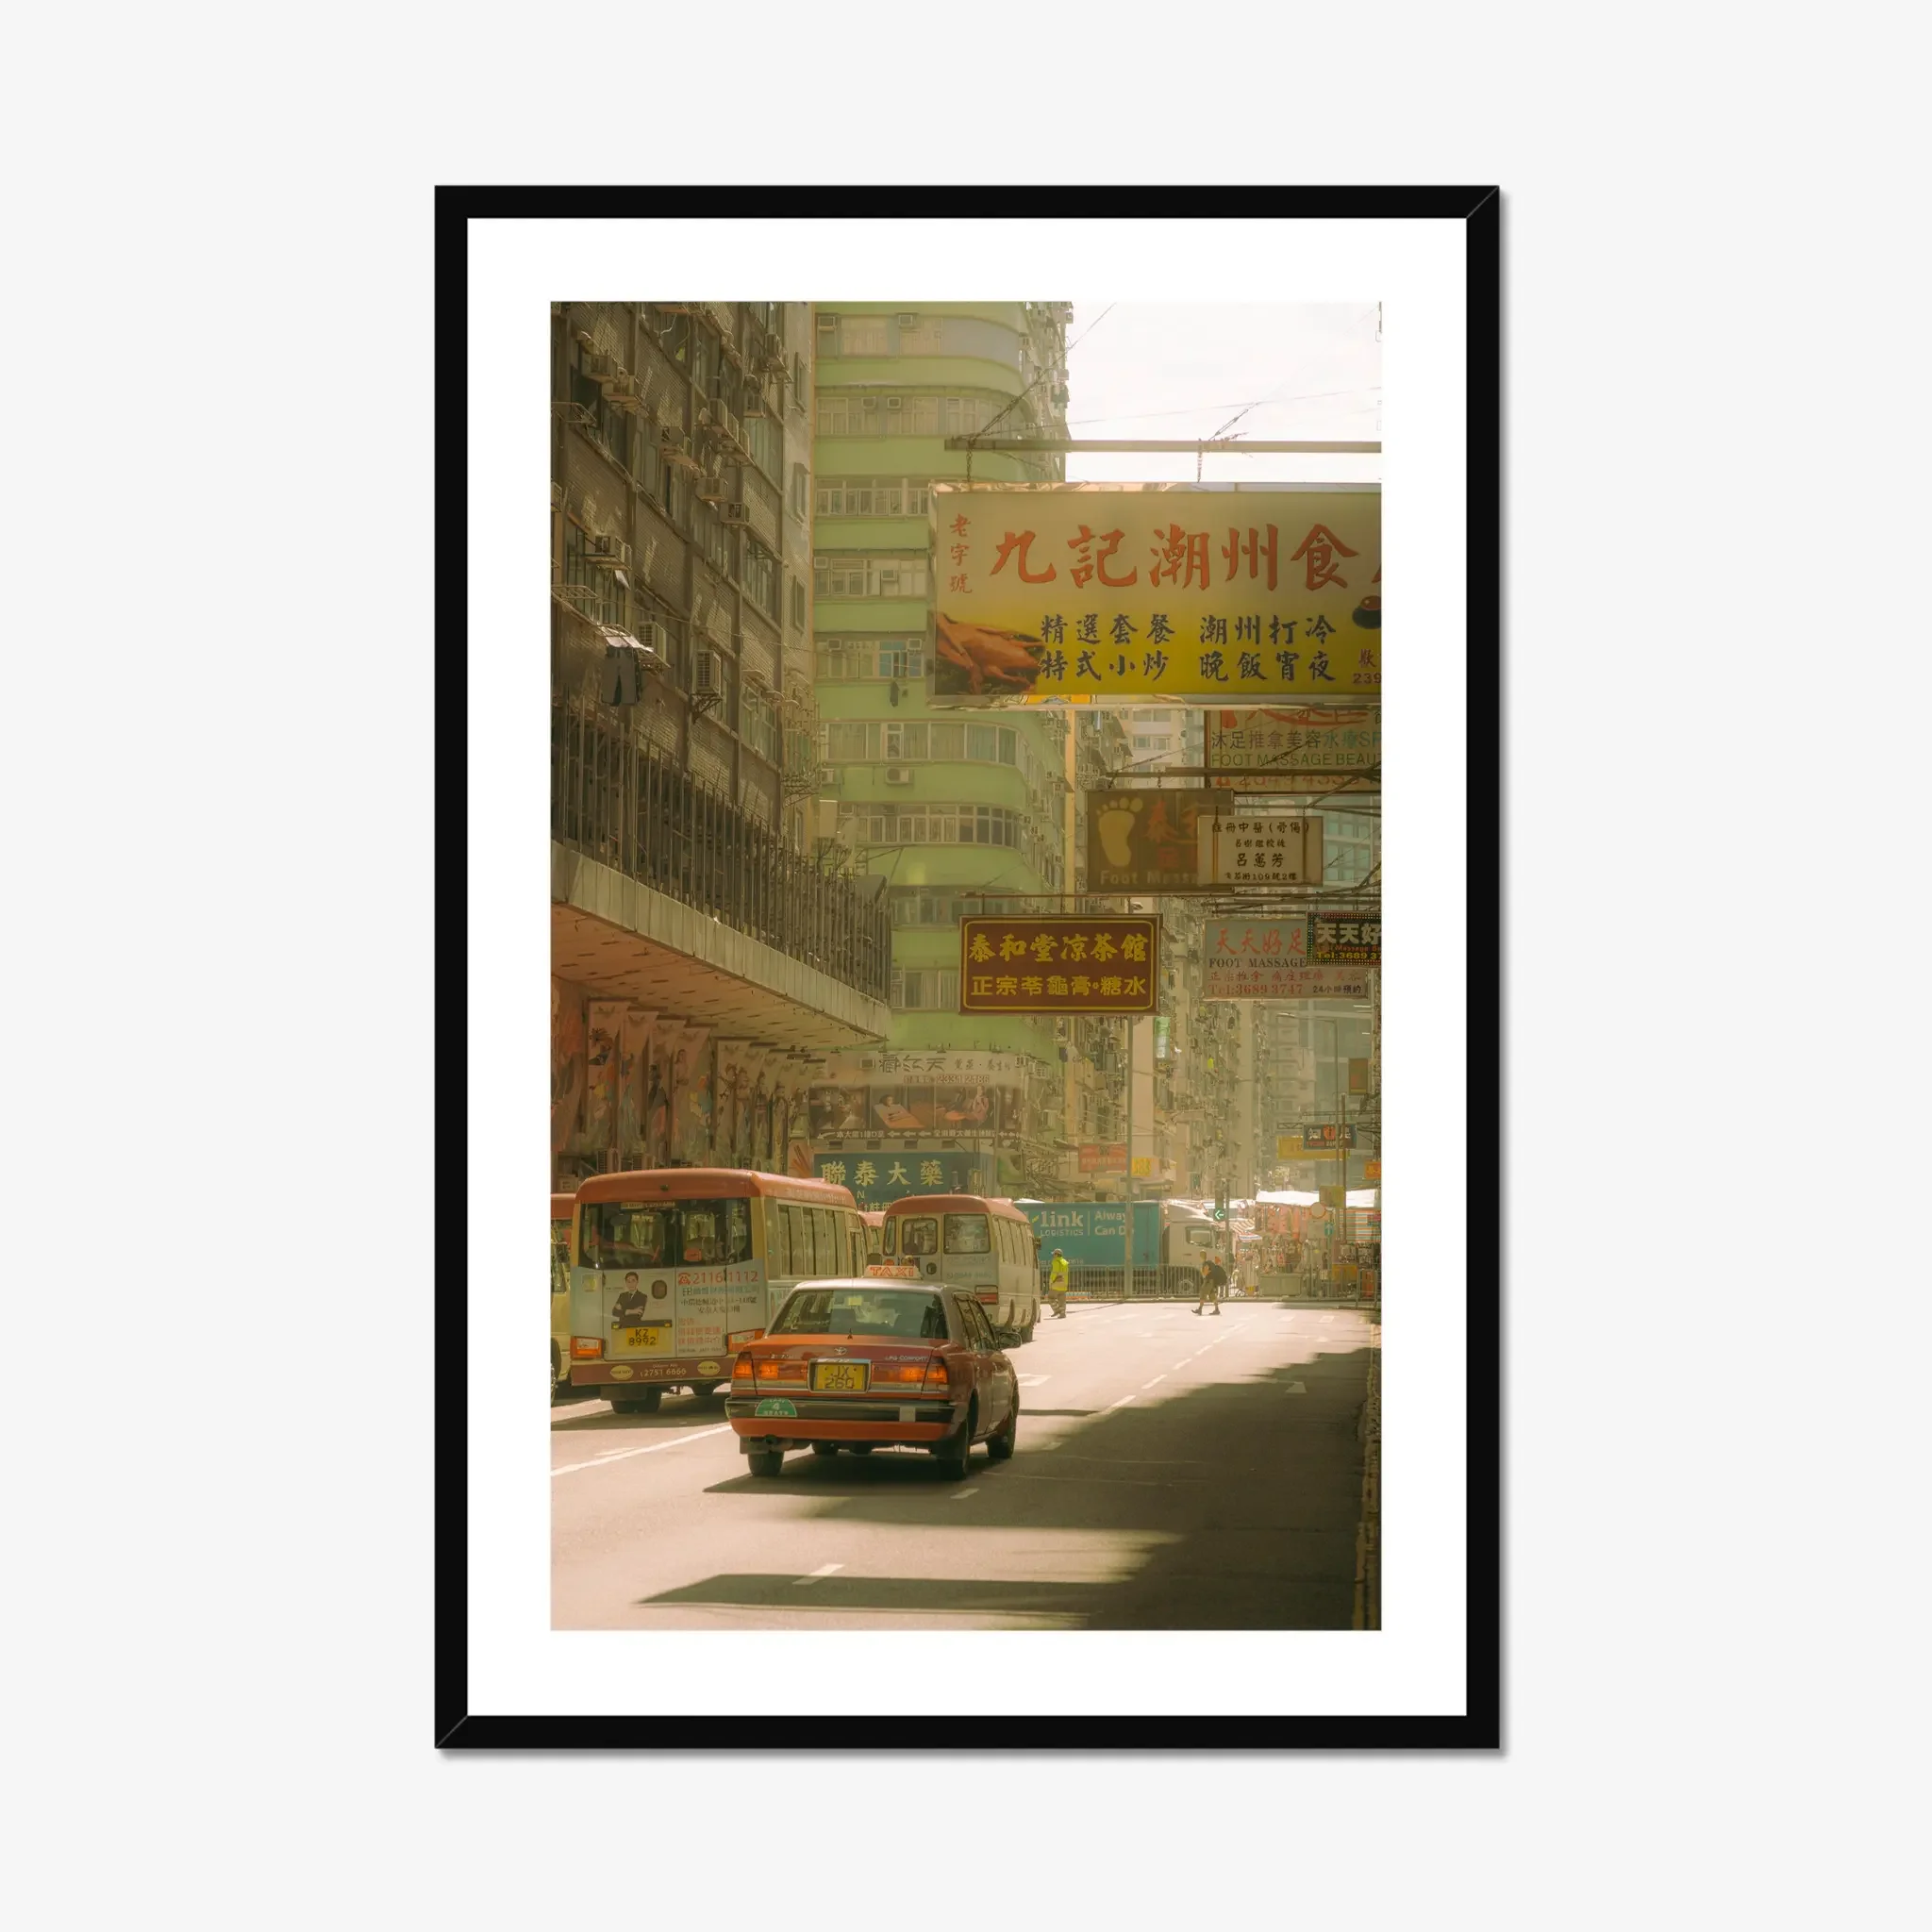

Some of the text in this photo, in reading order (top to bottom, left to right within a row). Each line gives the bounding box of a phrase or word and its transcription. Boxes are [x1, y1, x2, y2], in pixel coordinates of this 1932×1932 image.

[949, 512, 973, 594] 老字號
[989, 522, 1381, 591] 九記潮州食
[1041, 613, 1337, 645] 精選套餐 潮州打冷
[1211, 754, 1254, 767] FOOT
[1257, 754, 1333, 767] MASSAGE
[1100, 870, 1138, 885] Foot
[1209, 958, 1306, 968] FOOT MASSAGE
[1040, 1210, 1084, 1227] link
[1094, 1225, 1116, 1236] Can
[870, 1267, 914, 1277] TAXI
[635, 1328, 649, 1337] KZ
[628, 1337, 657, 1345] 8992
